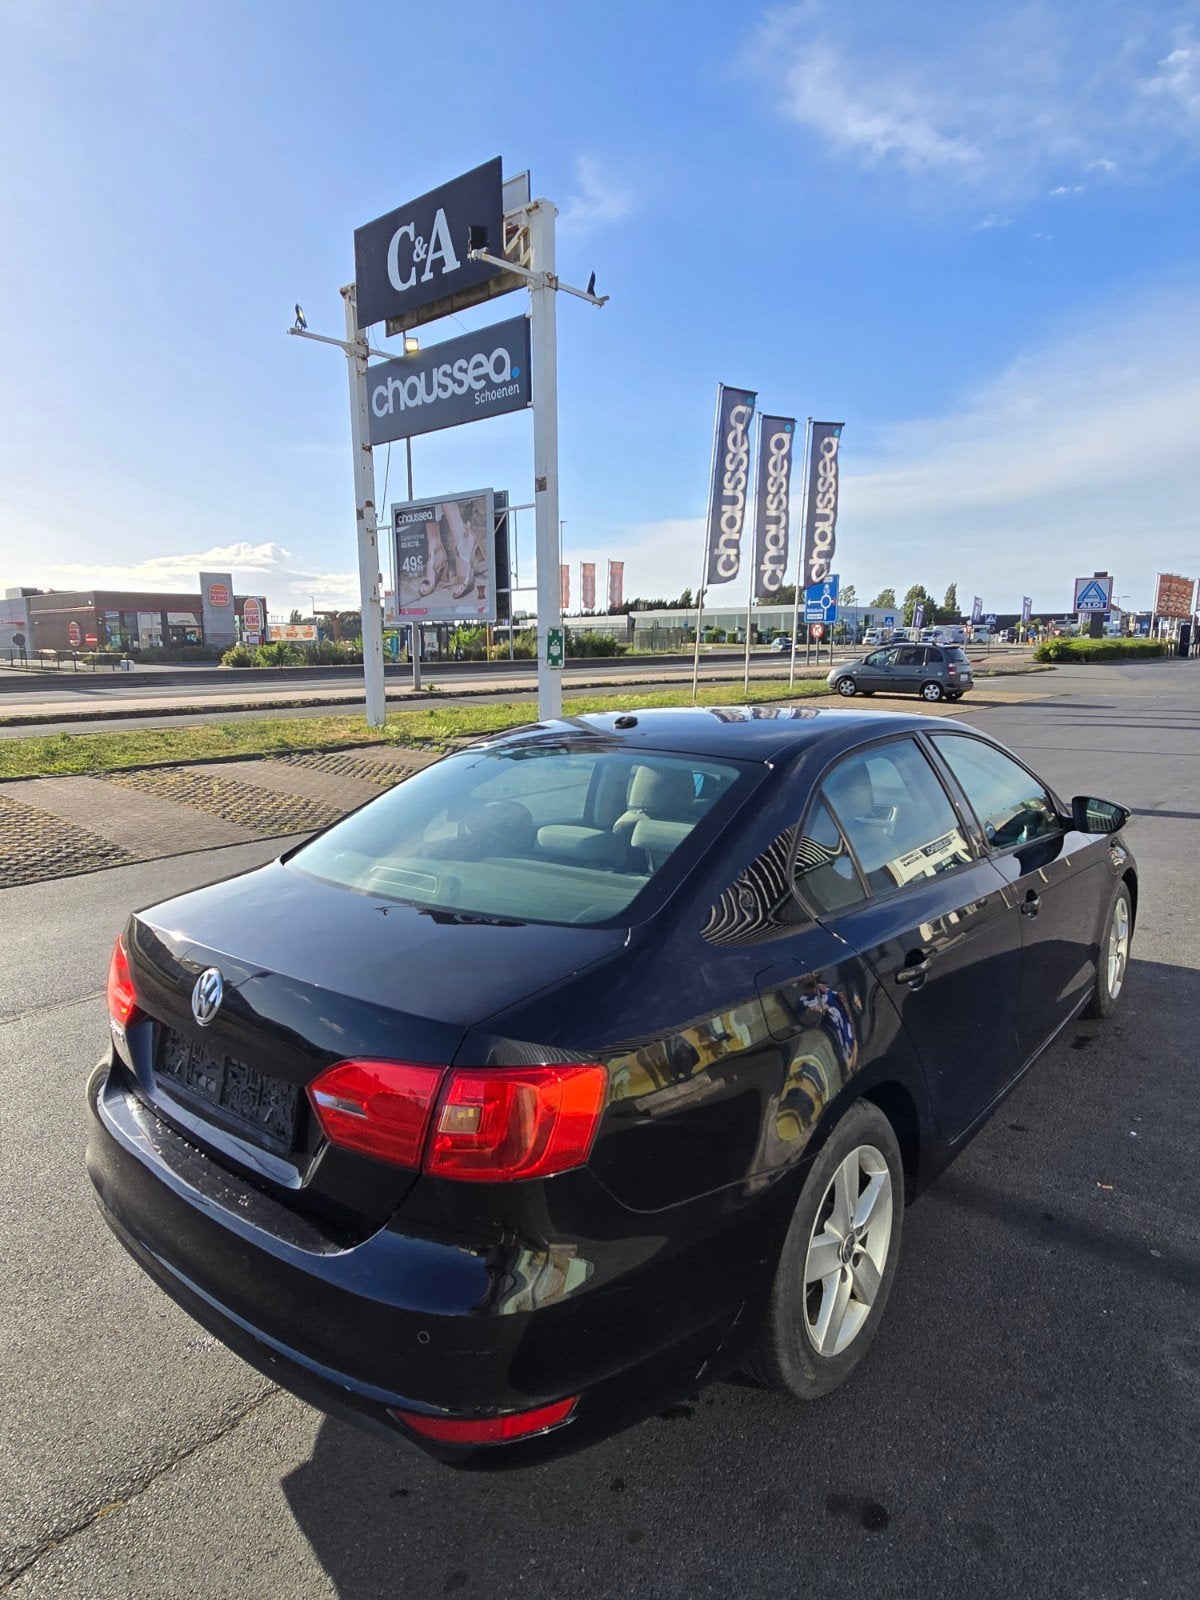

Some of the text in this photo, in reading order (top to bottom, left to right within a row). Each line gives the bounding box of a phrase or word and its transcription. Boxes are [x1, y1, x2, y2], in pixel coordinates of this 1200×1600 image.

[387, 207, 460, 292] C&A
[474, 382, 520, 405] Schoenen
[245, 615, 260, 624] KING
